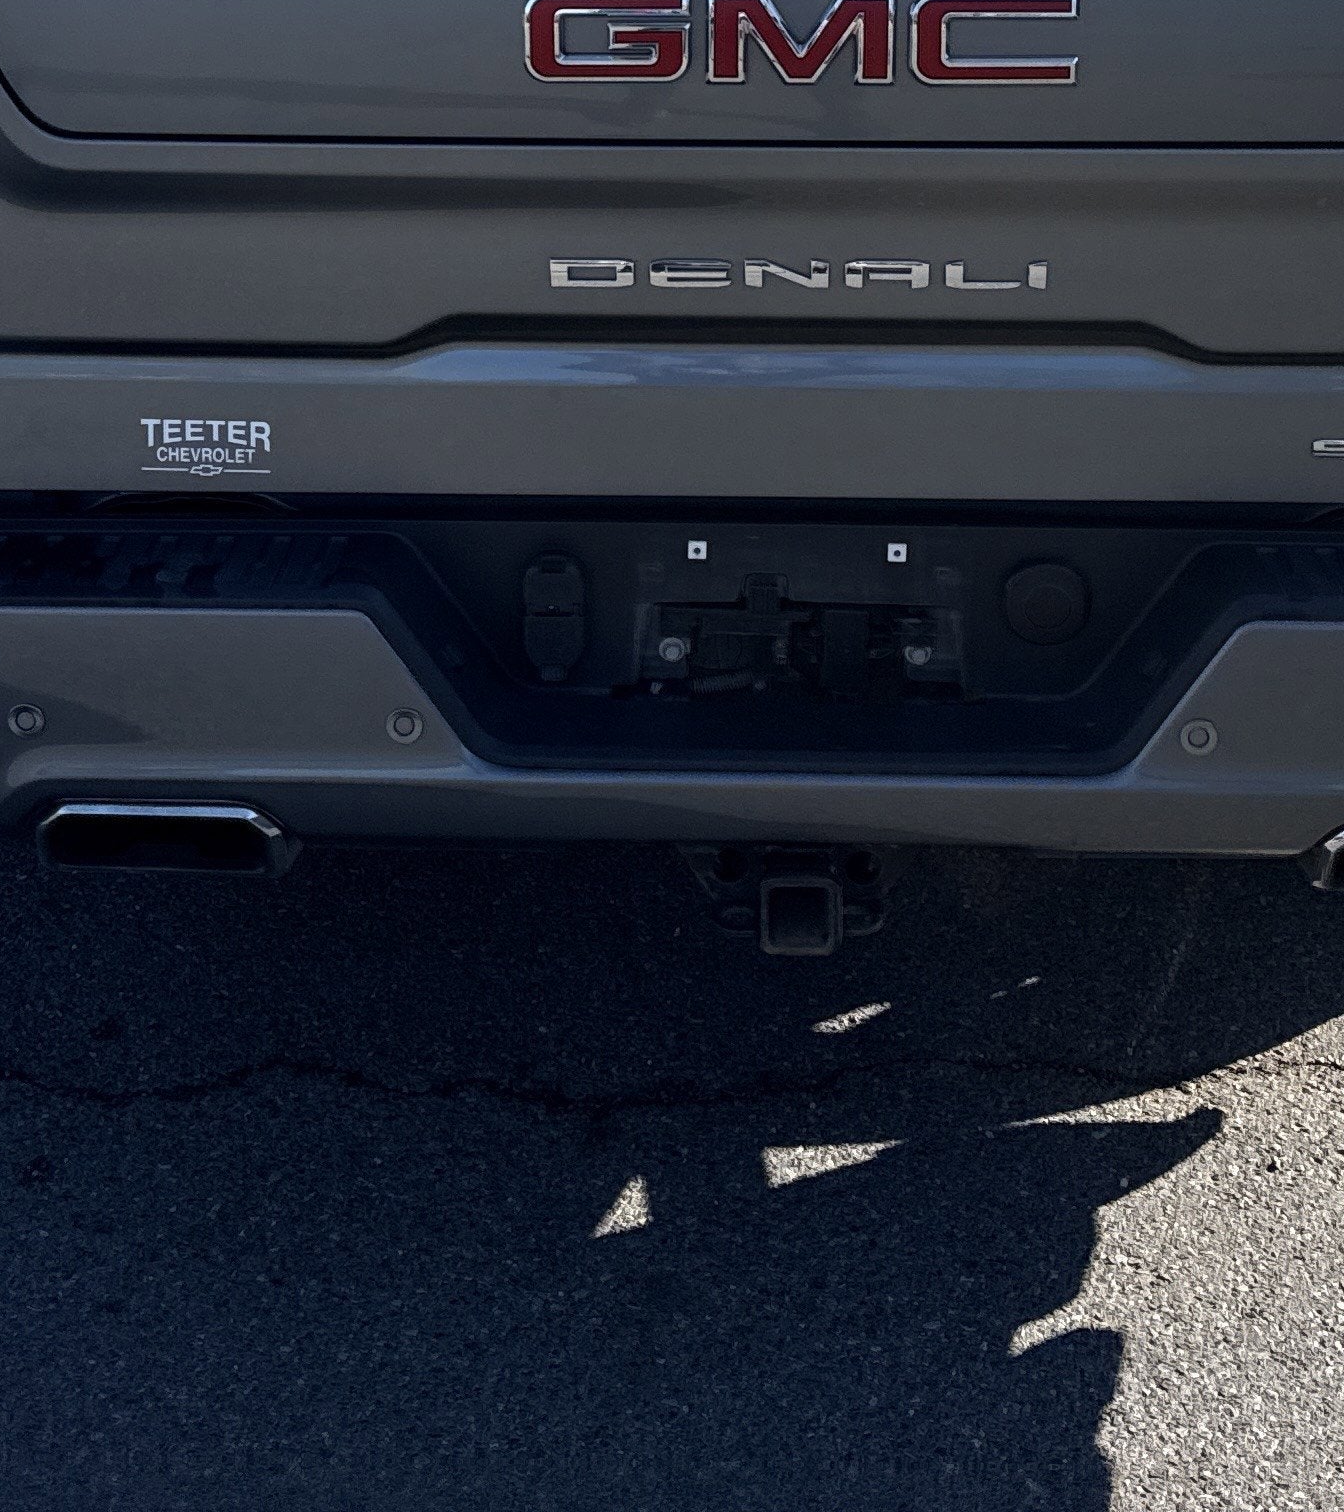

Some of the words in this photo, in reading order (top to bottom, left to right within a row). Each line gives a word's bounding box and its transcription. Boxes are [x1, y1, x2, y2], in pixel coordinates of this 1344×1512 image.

[549, 258, 1048, 290] DENALI
[140, 418, 271, 453] TEETER
[156, 446, 256, 464] CHEVROLET
